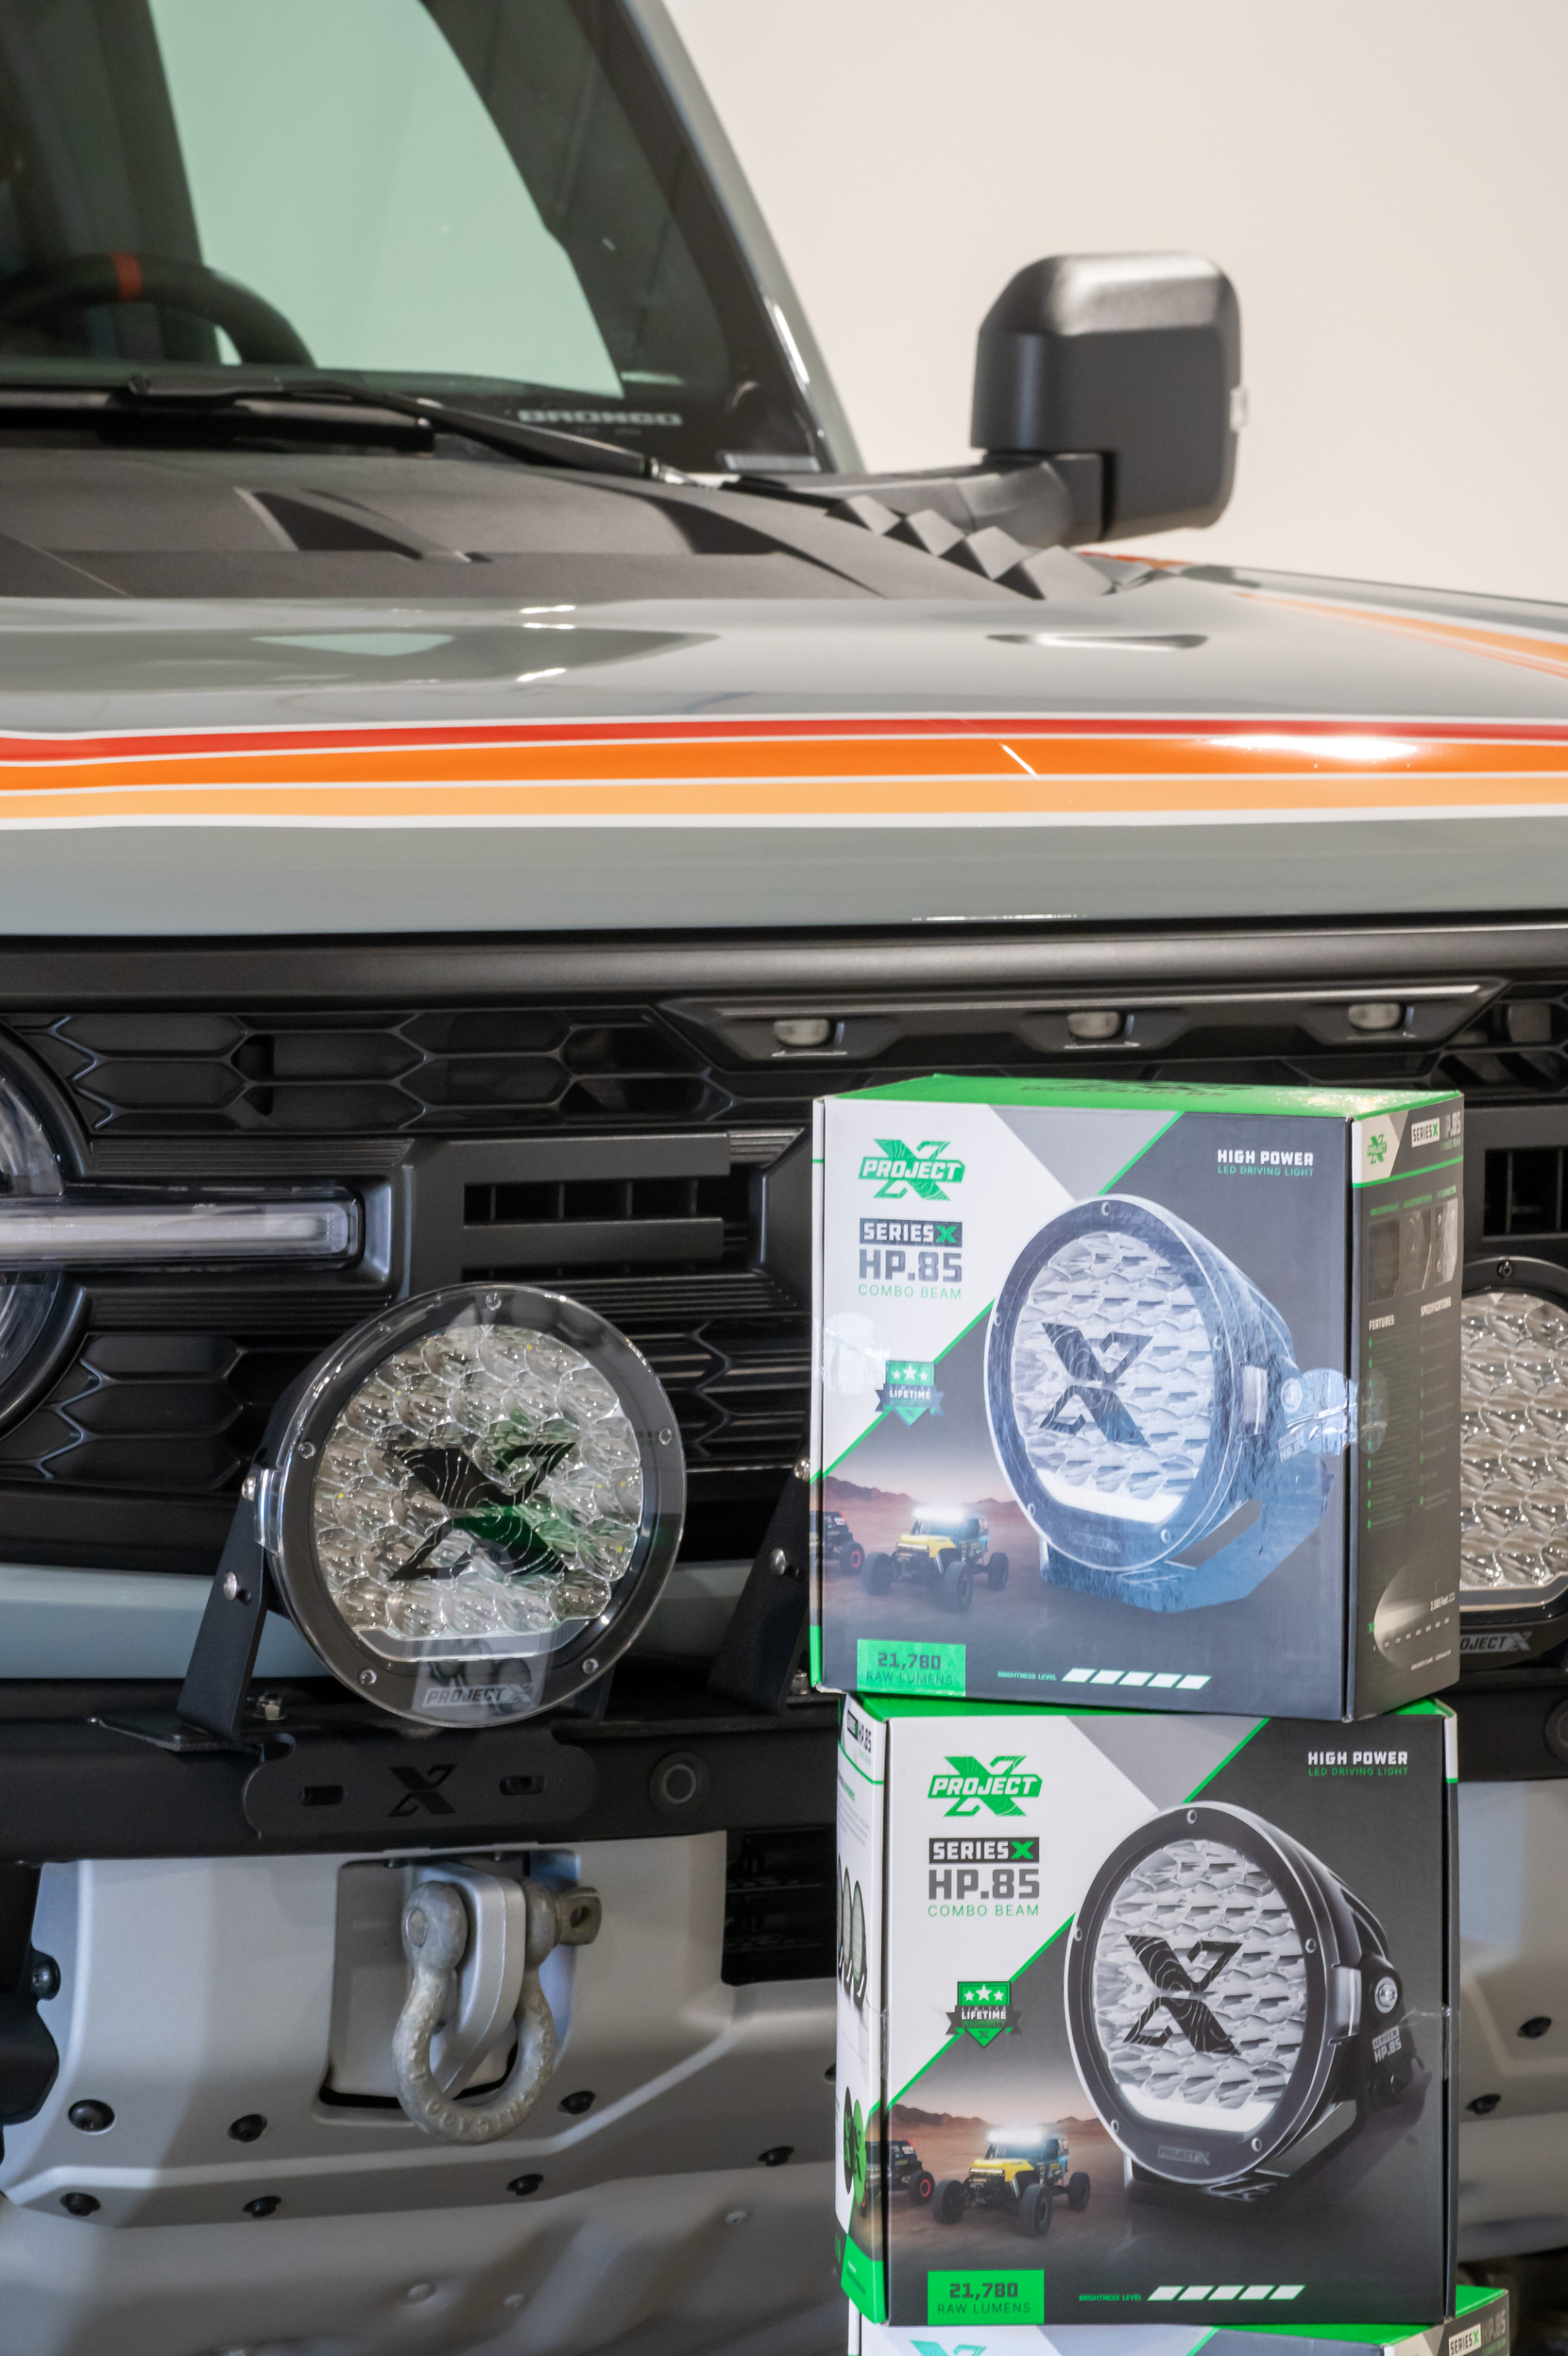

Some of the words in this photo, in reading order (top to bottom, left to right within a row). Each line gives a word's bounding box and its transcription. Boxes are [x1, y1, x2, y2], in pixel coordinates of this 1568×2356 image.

[1218, 1149, 1256, 1165] HIGH
[1260, 1151, 1314, 1166] POWER
[862, 1160, 964, 1181] PROJECT
[1218, 1165, 1236, 1175] LED
[1240, 1165, 1281, 1176] DRIVING
[1285, 1168, 1315, 1178] LIGHT
[859, 1249, 963, 1283] HP.85
[858, 1284, 915, 1298] COMBO
[920, 1286, 962, 1300] BEAM
[889, 1389, 931, 1400] LIFETIME
[1459, 1636, 1508, 1650] OJECT
[878, 1652, 942, 1671] 21,780
[866, 1671, 893, 1682] RAW
[899, 1672, 953, 1686] LUMENS
[1037, 1673, 1057, 1681] LEVEL
[426, 1686, 507, 1704] PROJECT
[1307, 1751, 1348, 1766] HIGH
[1352, 1751, 1408, 1766] POWER
[1308, 1766, 1328, 1776] LED
[1331, 1766, 1374, 1776] DRIVING
[1378, 1766, 1409, 1776] LIGHT
[931, 1775, 1039, 1796] PROJECT
[929, 1868, 1040, 1900] HP.85
[928, 1904, 988, 1917] COMBO
[995, 1904, 1040, 1917] BEAM
[961, 2010, 1006, 2020] LIFETIME
[950, 2283, 1018, 2301] 21,780
[1079, 2293, 1120, 2301] BRIGHTNESS
[1121, 2293, 1143, 2301] LEVEL
[938, 2303, 967, 2314] RAW
[973, 2302, 1031, 2314] LUMENS
